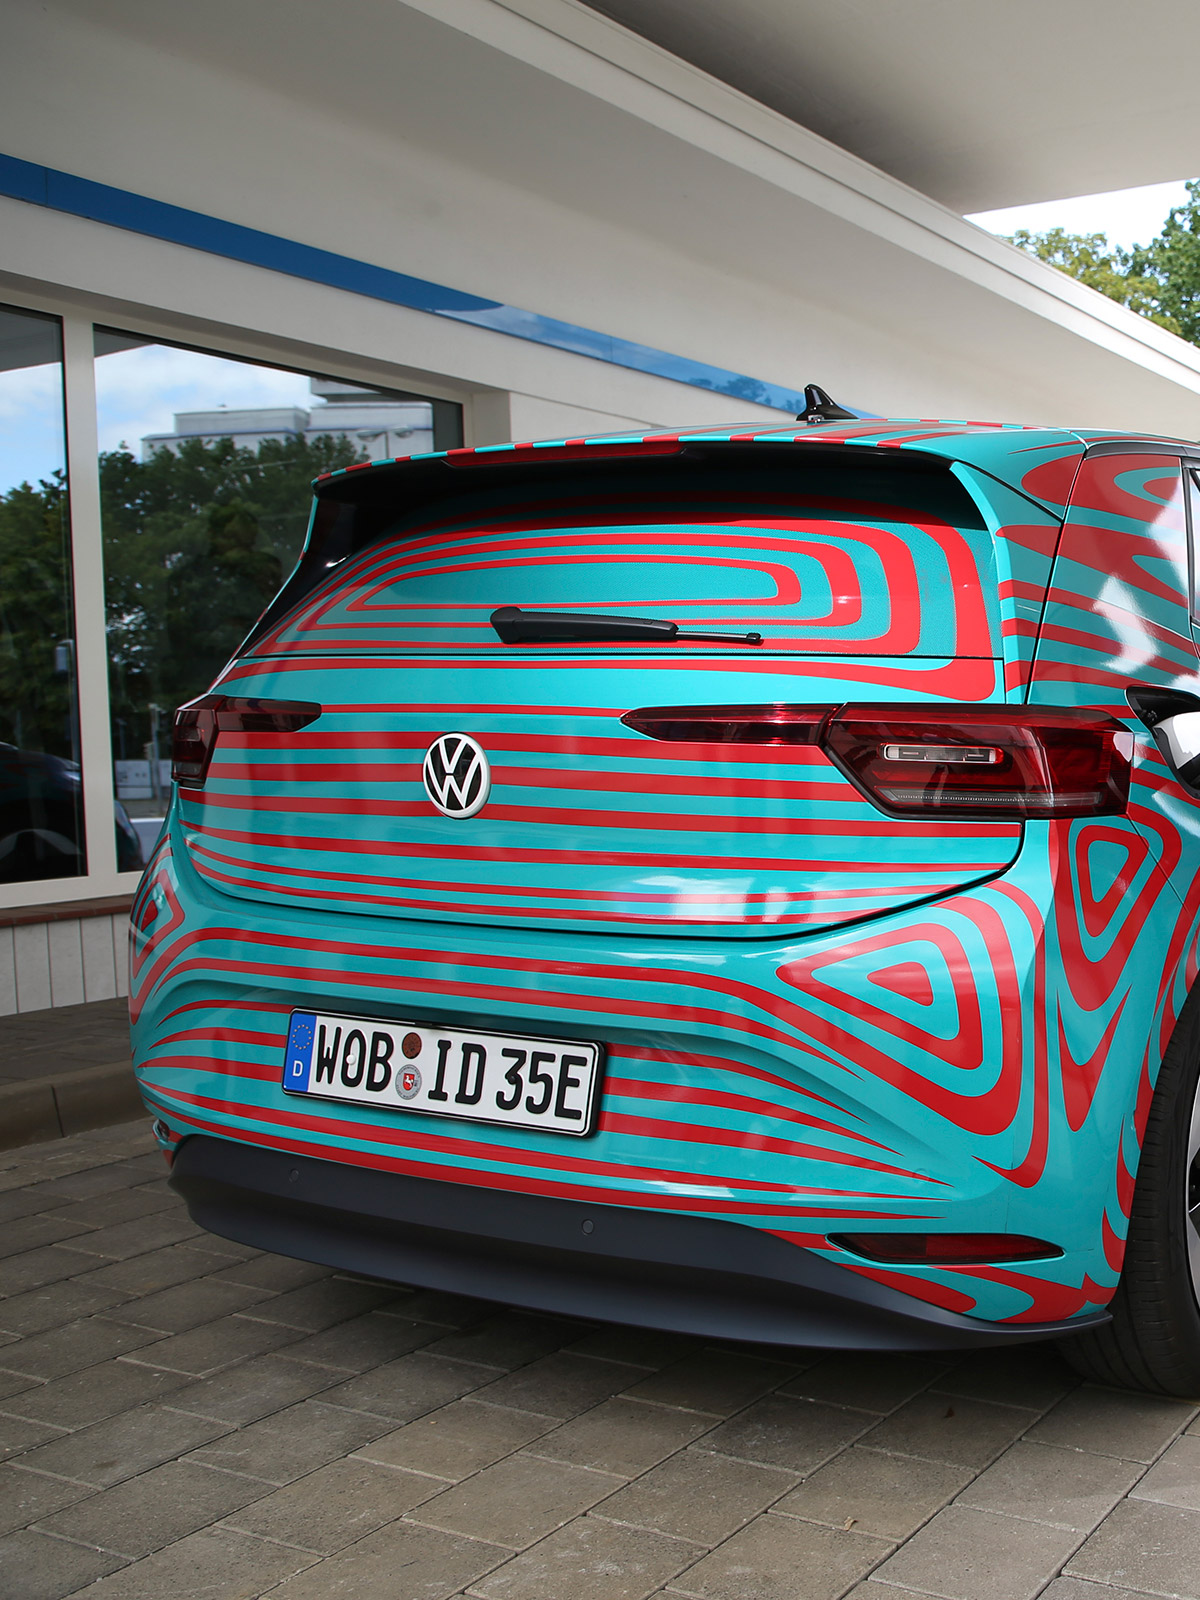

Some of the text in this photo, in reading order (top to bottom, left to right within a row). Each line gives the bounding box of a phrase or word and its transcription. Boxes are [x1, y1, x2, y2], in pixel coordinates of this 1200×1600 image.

[424, 734, 488, 817] VW
[292, 1060, 304, 1077] D
[315, 1024, 395, 1092] WOB
[428, 1039, 487, 1105] ID
[496, 1047, 588, 1120] 35E
